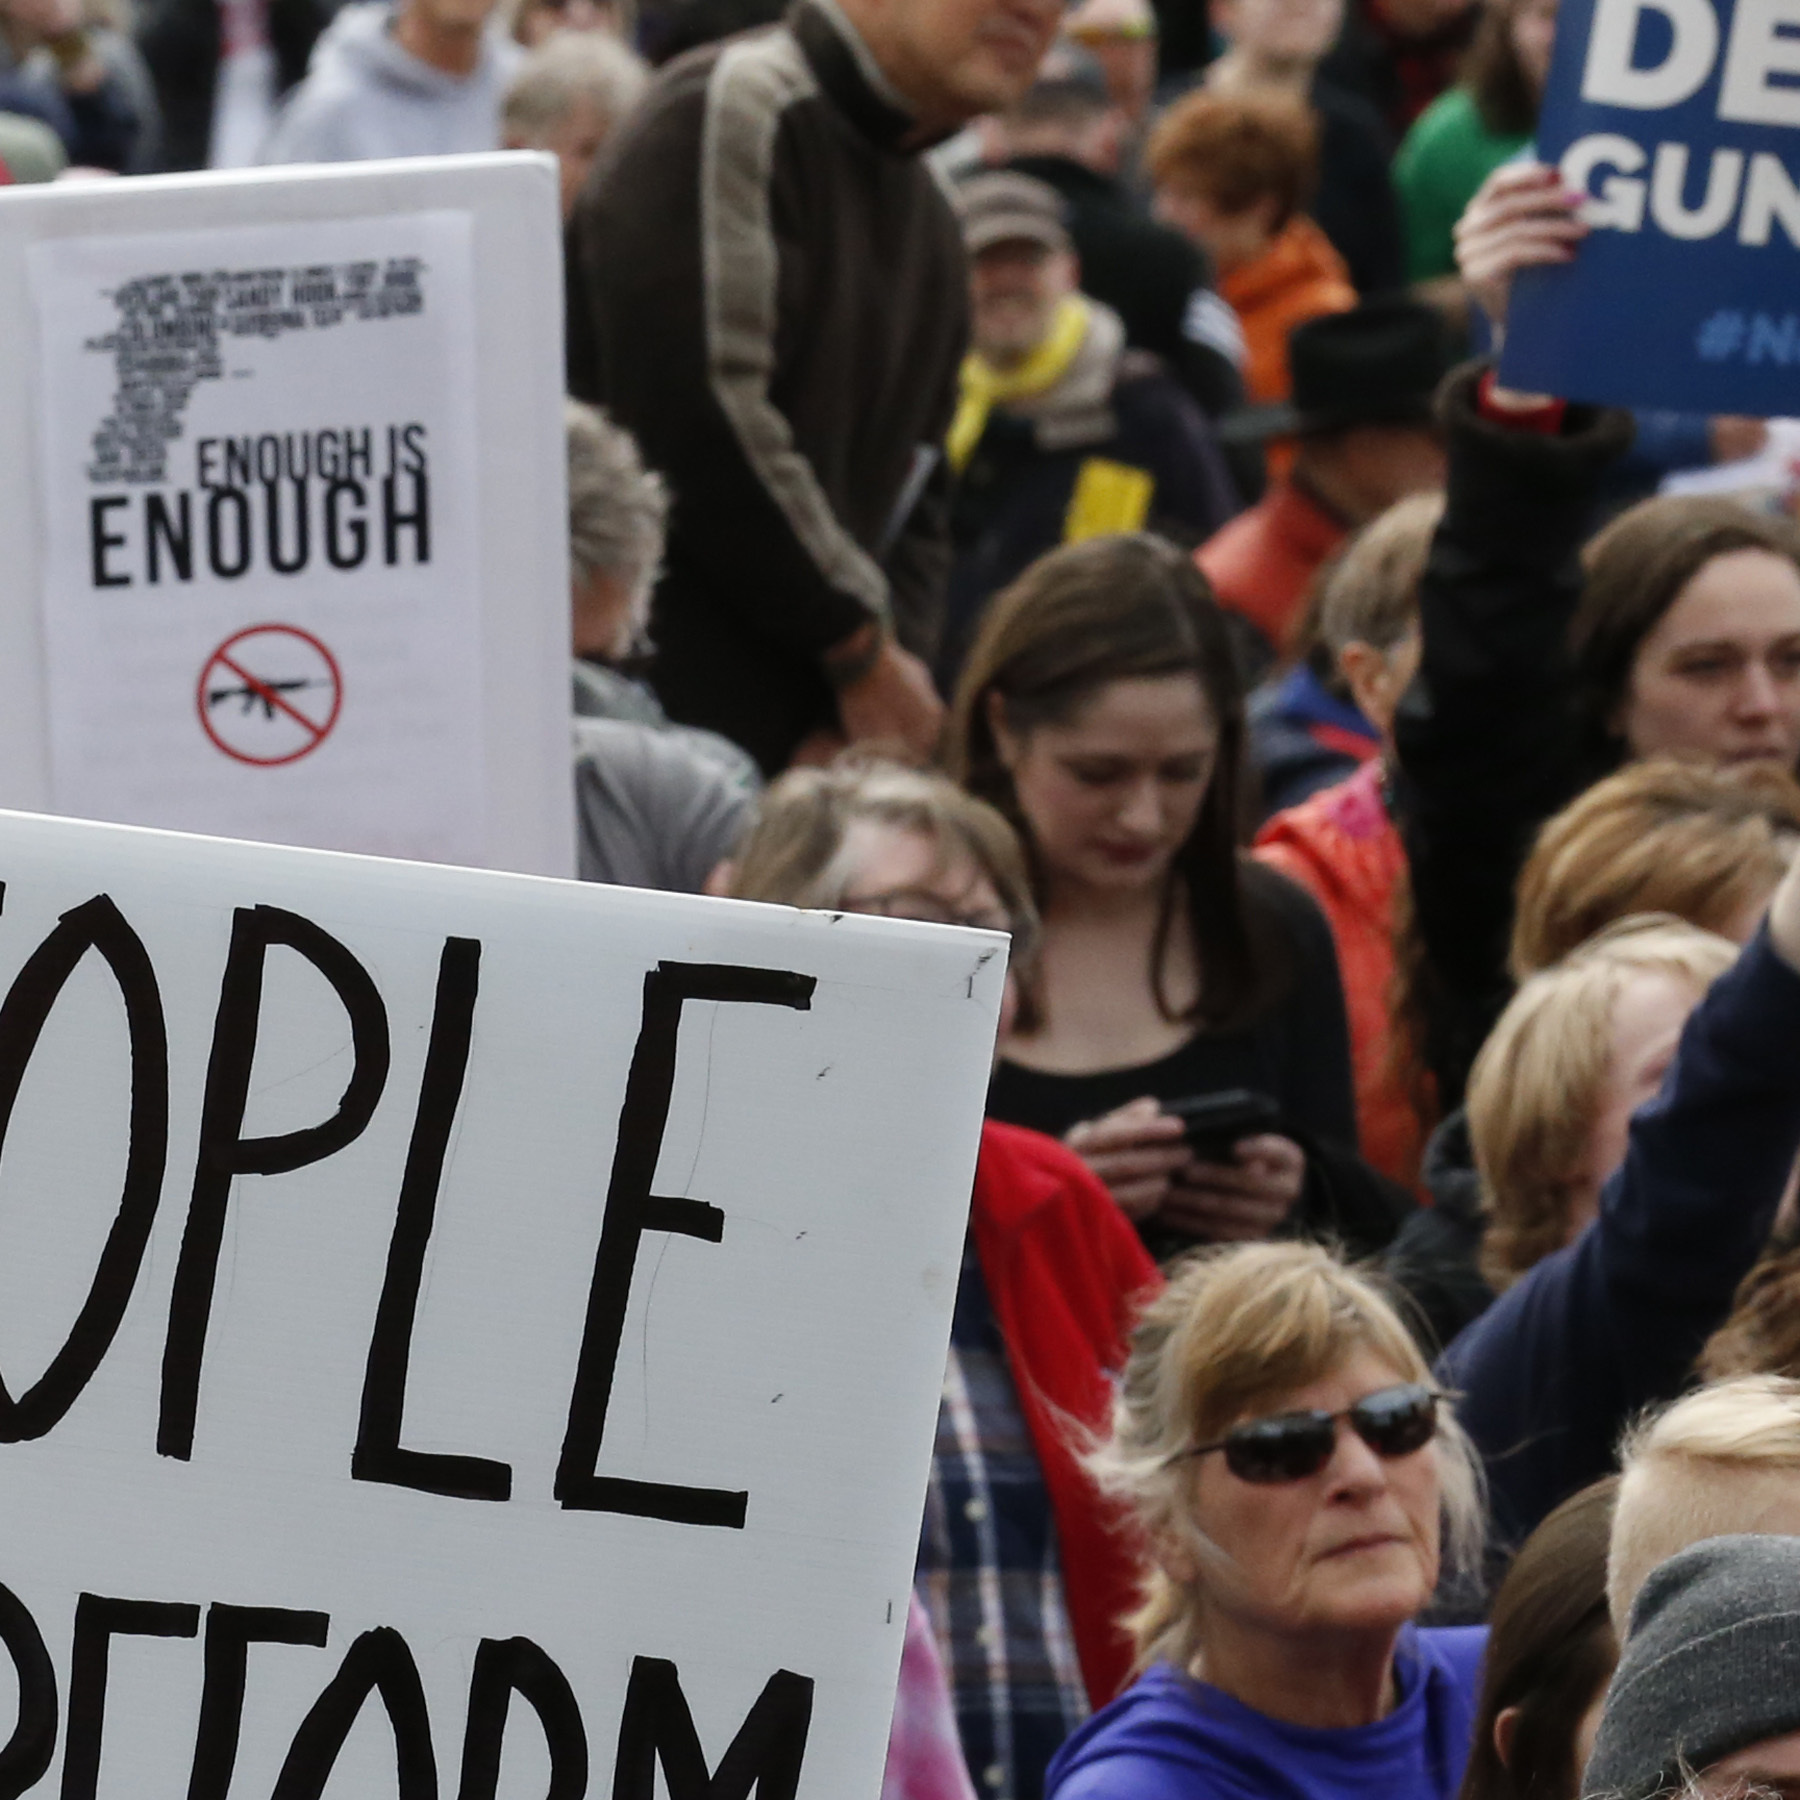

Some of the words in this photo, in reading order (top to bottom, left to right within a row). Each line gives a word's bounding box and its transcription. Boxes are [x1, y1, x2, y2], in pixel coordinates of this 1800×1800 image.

[196, 425, 374, 490] ENOUGH
[385, 422, 427, 478] IS
[91, 472, 430, 589] ENOUGH
